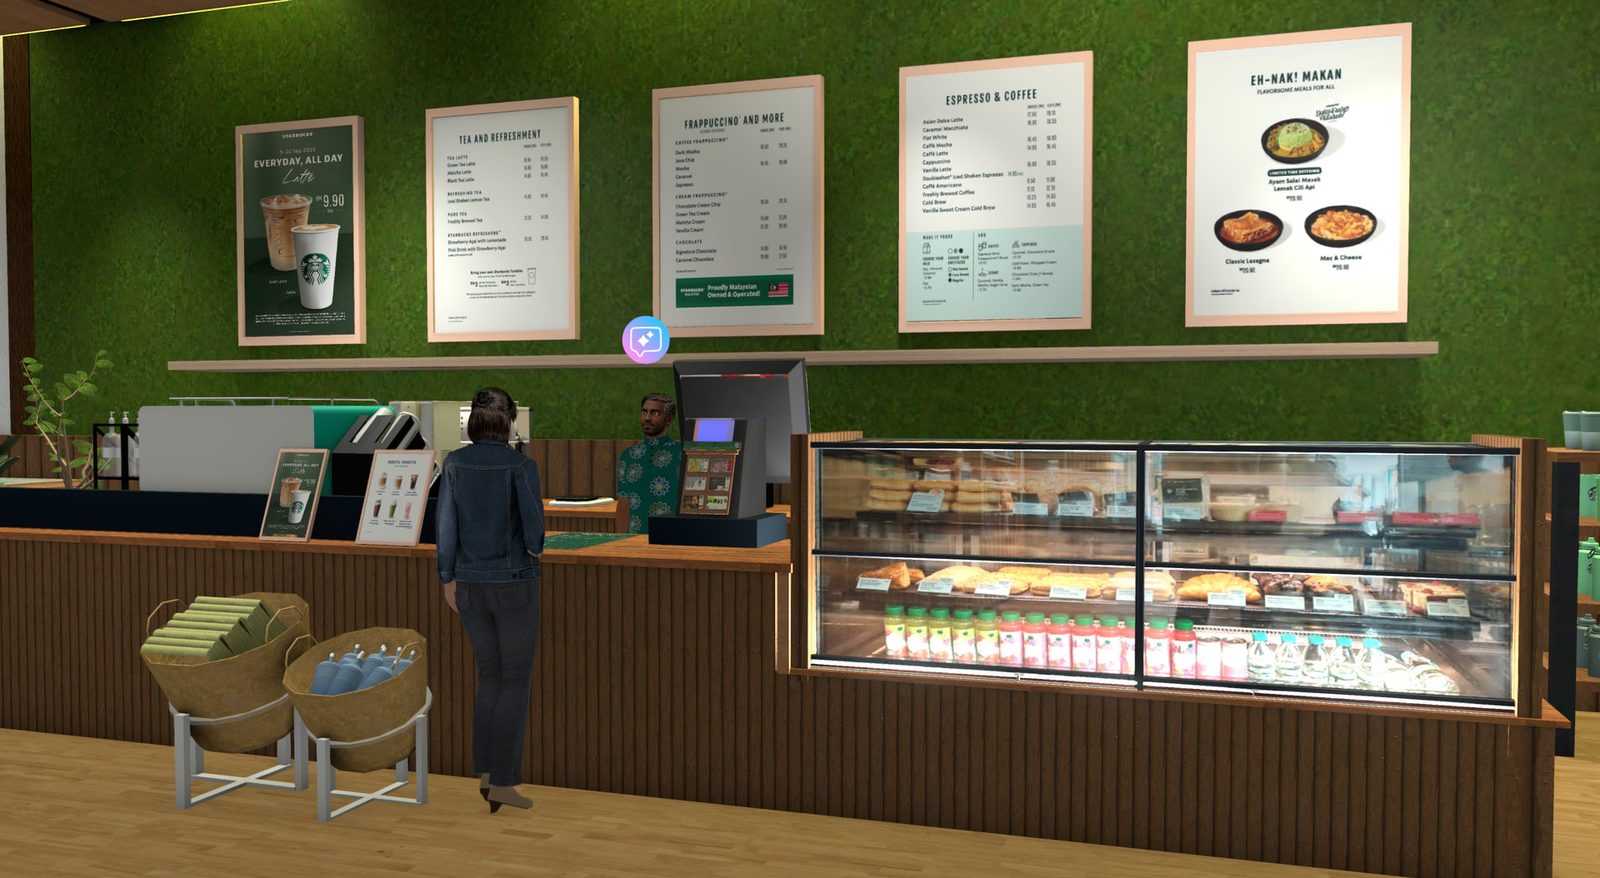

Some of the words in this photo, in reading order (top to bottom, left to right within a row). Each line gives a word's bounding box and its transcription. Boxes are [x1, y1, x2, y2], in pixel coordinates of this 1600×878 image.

[1251, 72, 1298, 86] EH-NAK!
[1302, 68, 1342, 82] MAKAN
[946, 93, 991, 106] ESPRESSO
[994, 92, 1000, 102] &
[1005, 89, 1037, 101] COFFEE
[743, 115, 758, 125] AND
[762, 113, 784, 123] MORE
[459, 135, 471, 144] TEA
[474, 134, 488, 143] AND
[491, 129, 541, 142] REFRESHMENT
[254, 157, 303, 168] EVERYDAY,
[305, 156, 321, 164] ALL
[324, 154, 343, 162] DAY
[282, 168, 315, 184] Latte
[324, 194, 344, 207] 9.90
